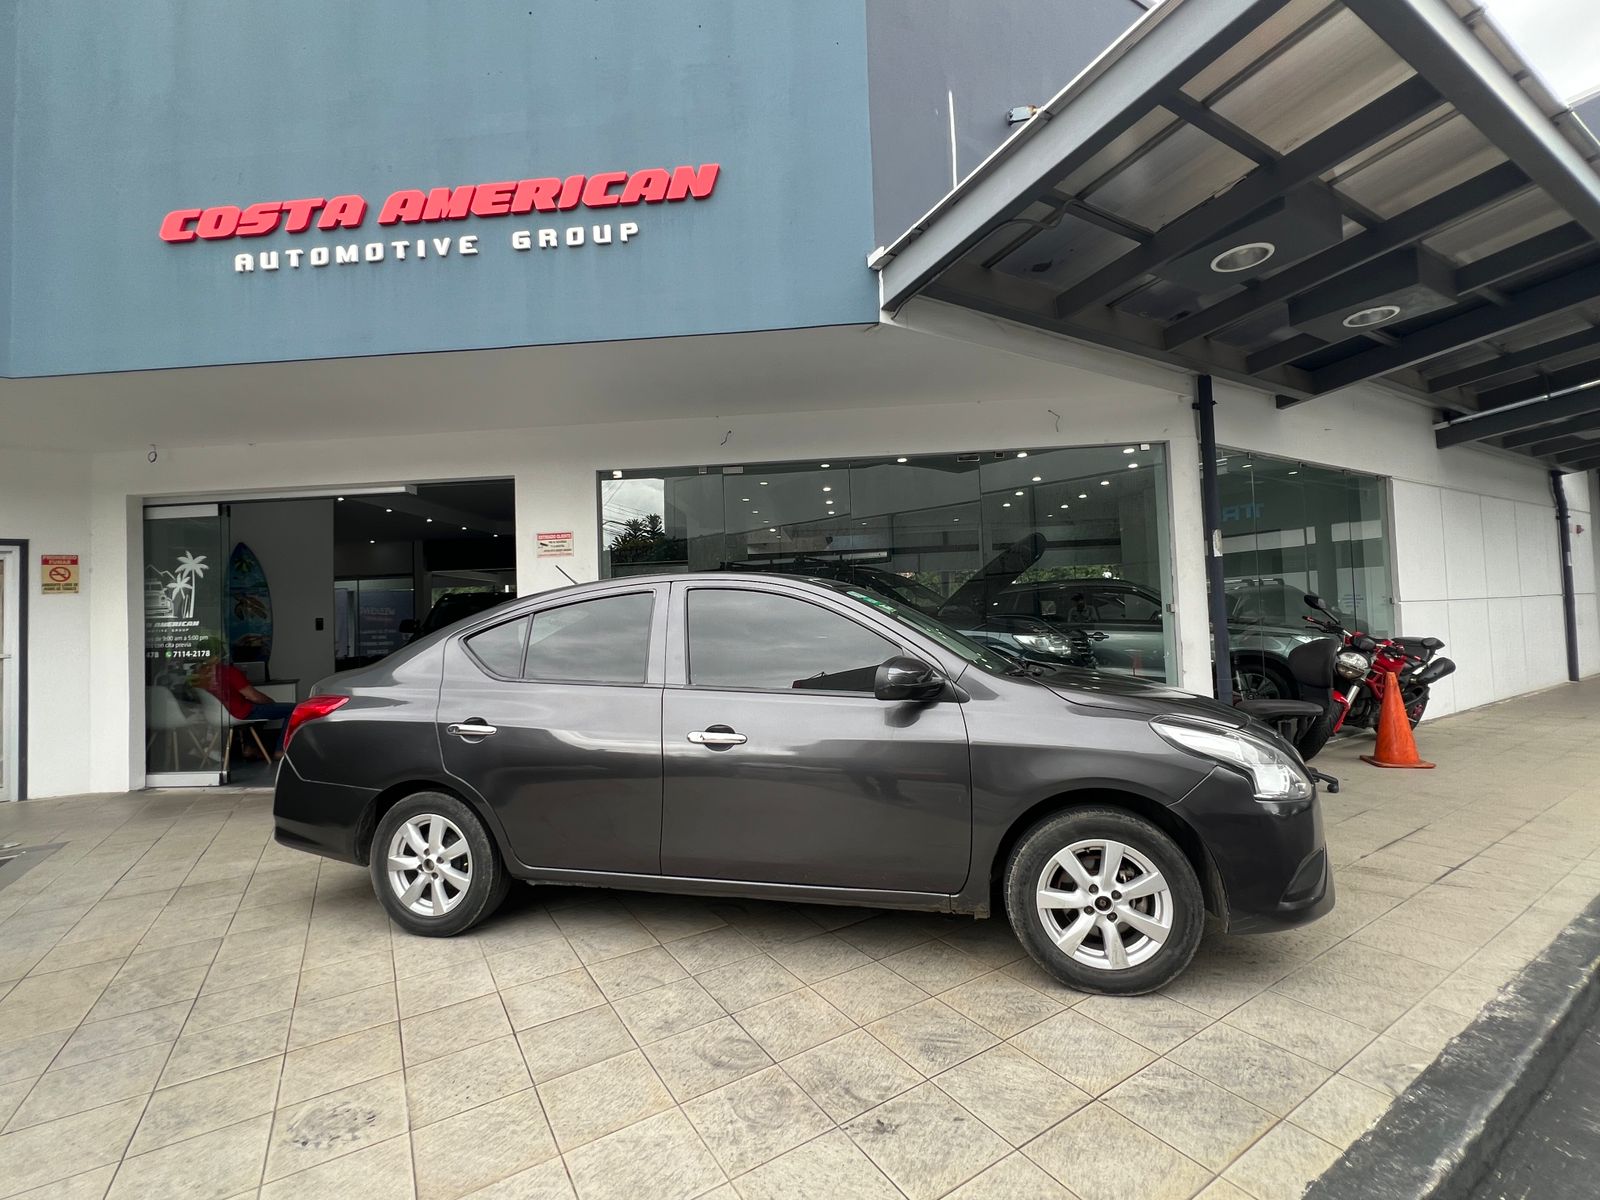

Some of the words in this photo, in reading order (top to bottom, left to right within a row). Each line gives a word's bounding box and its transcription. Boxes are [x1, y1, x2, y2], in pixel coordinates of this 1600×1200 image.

[159, 194, 368, 243] COSTA
[377, 163, 720, 224] AMERICAN
[234, 235, 479, 272] AUTOMOTIVE
[511, 222, 639, 250] GROUP
[173, 650, 211, 658] 7114-2178
